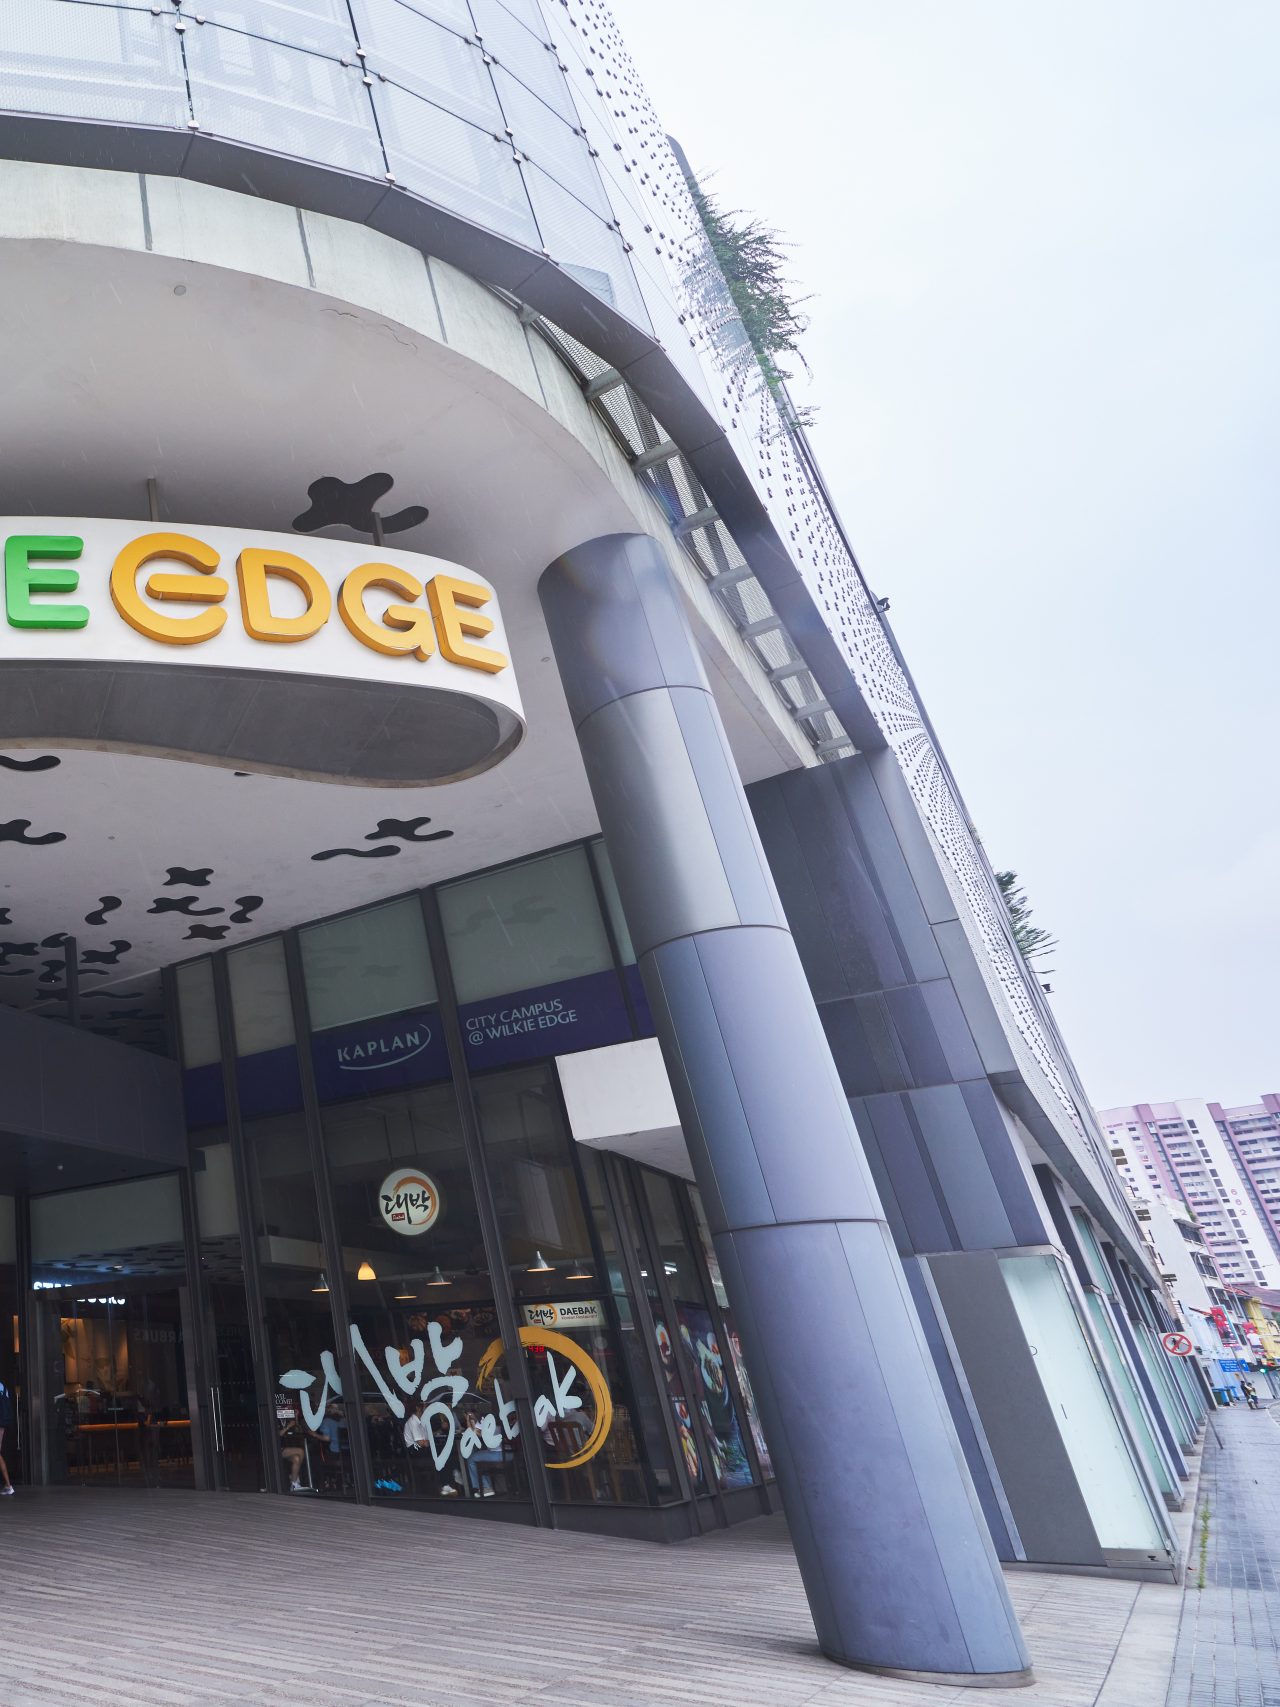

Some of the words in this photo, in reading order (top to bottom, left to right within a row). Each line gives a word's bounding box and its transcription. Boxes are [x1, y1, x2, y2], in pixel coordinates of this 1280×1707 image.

[109, 531, 509, 675] EDGE
[465, 1013, 497, 1031] CITY
[500, 998, 563, 1023] CAMPUS
[468, 1030, 484, 1046] @
[486, 1019, 536, 1040] WILKIE
[538, 1009, 578, 1030] EDGE
[337, 1031, 420, 1062] KAPLAN
[559, 1306, 597, 1316] DAEBAK
[421, 1351, 582, 1471] Daebak
